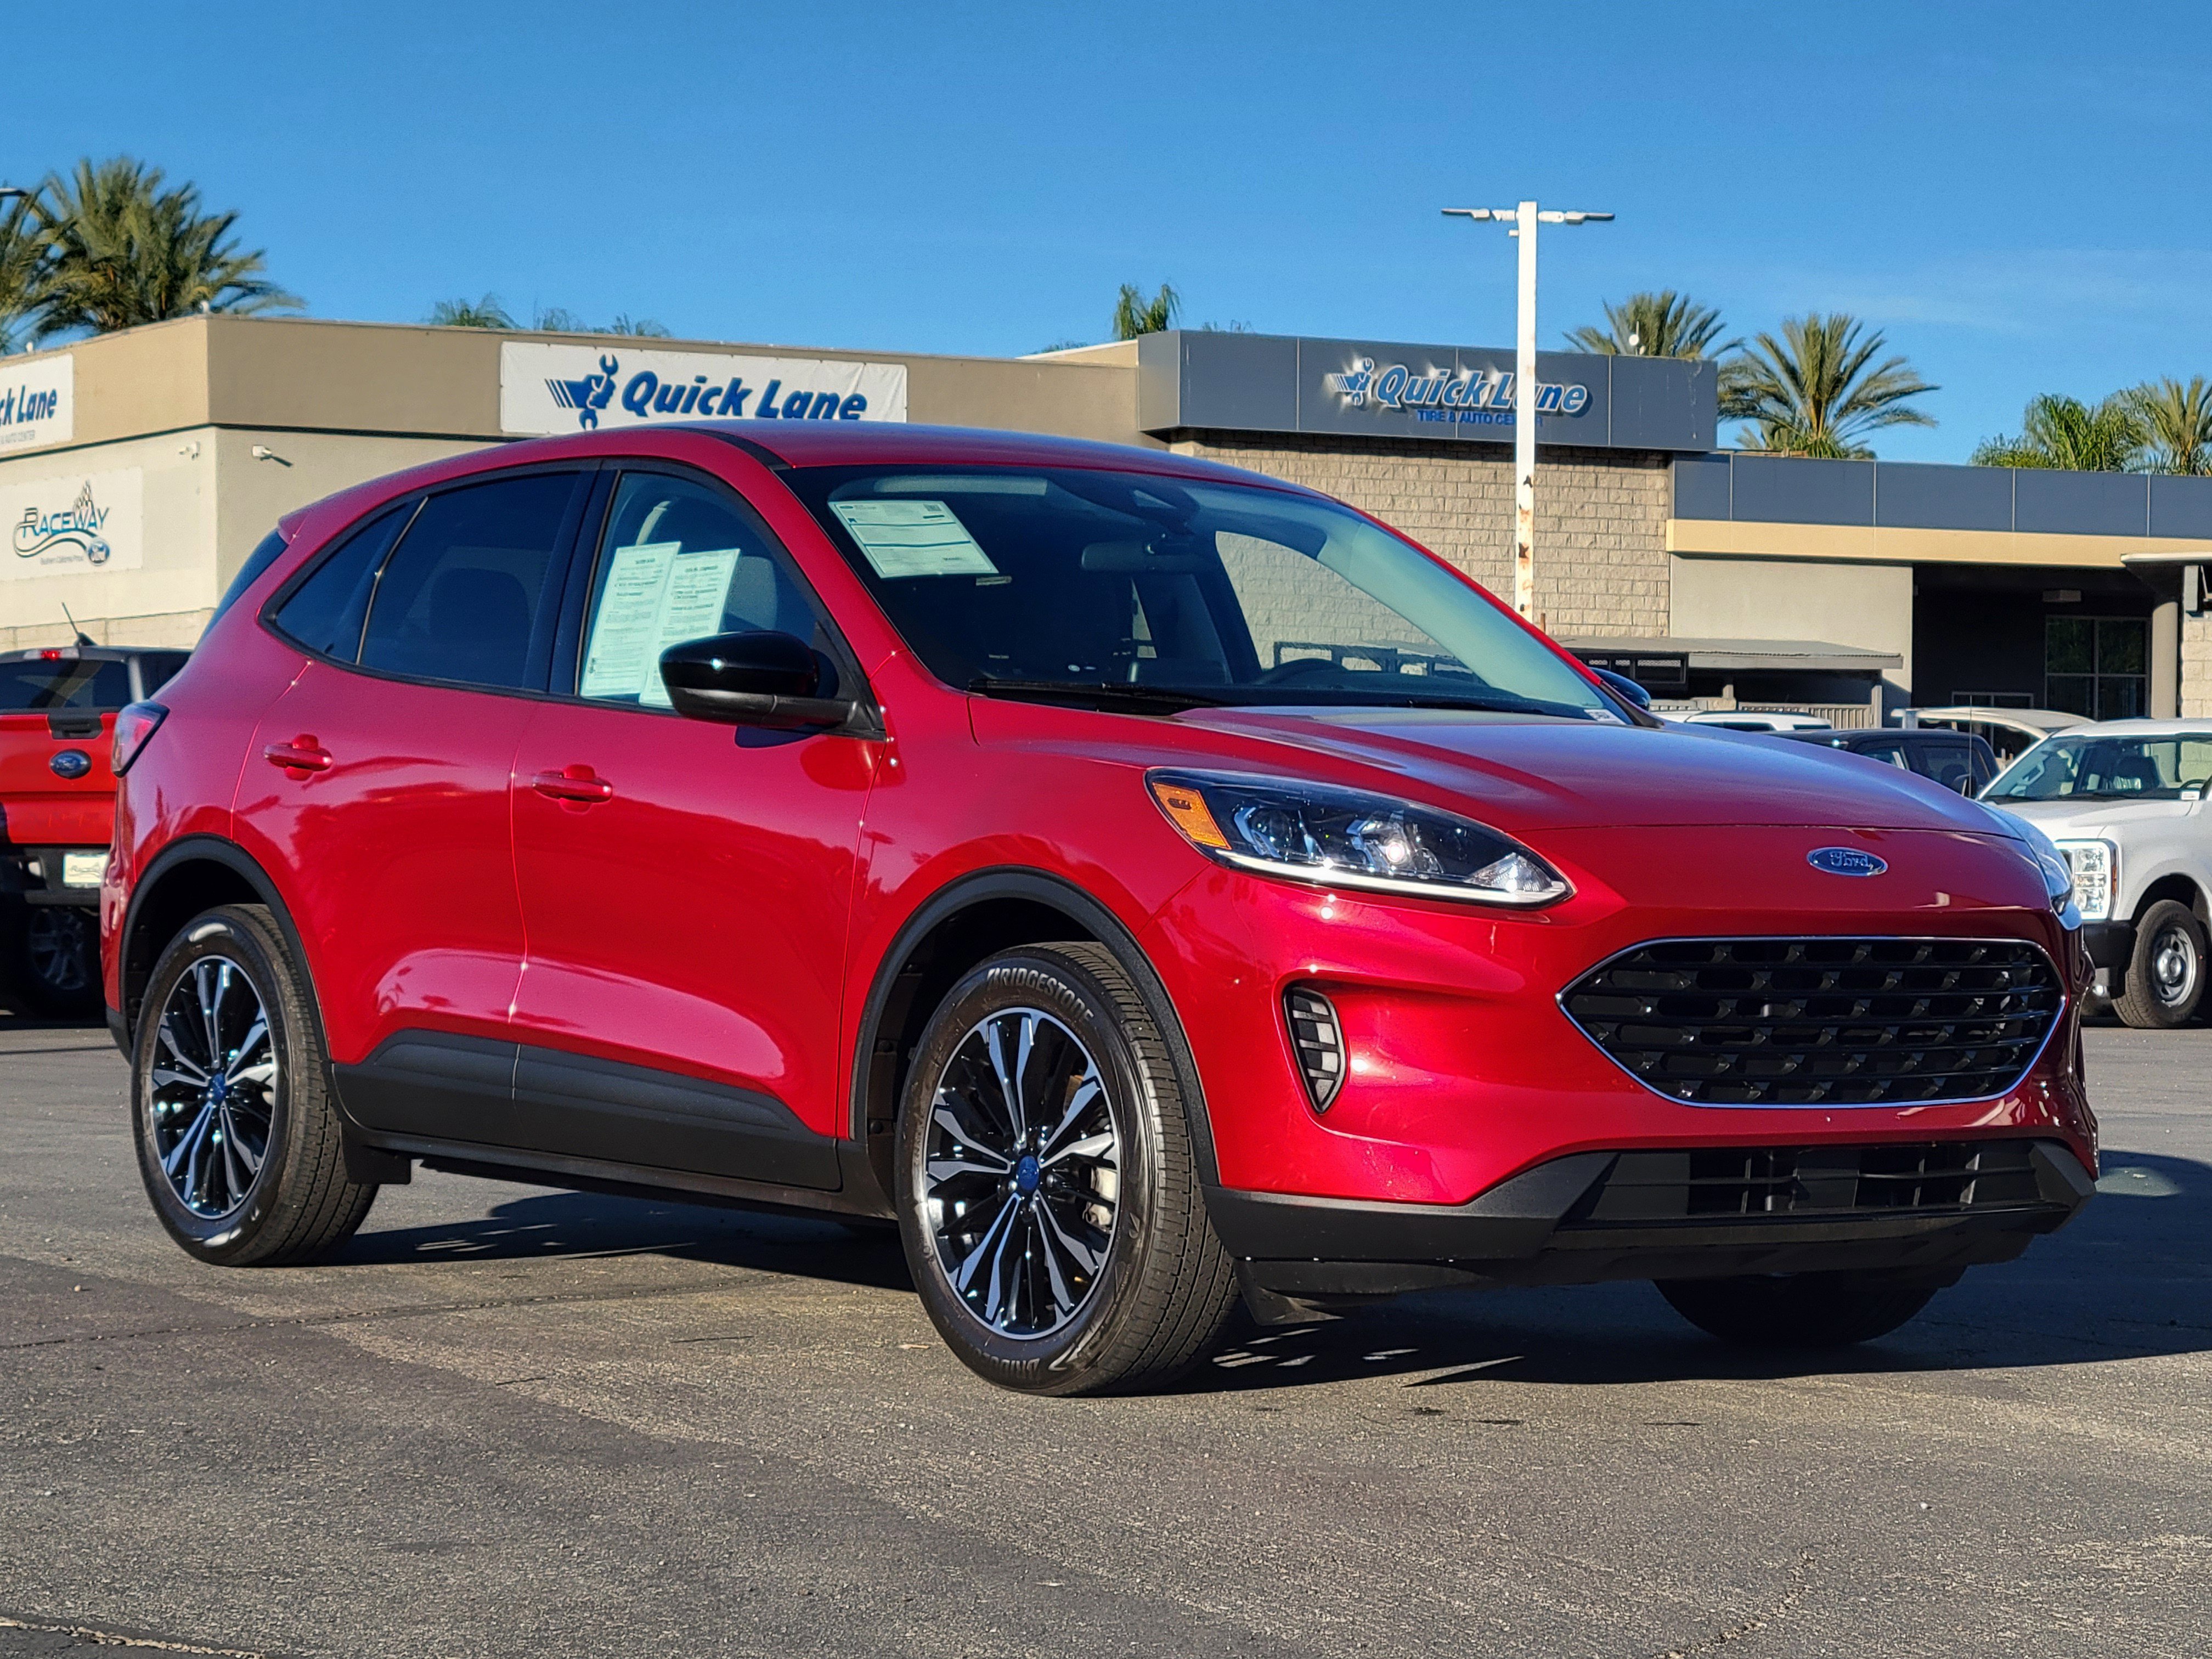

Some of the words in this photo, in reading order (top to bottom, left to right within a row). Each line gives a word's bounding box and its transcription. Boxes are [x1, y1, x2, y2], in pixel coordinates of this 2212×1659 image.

[16, 385, 57, 423] Lane
[621, 370, 753, 417] Quick
[755, 379, 867, 420] Lane
[1376, 365, 1488, 408] Quick
[1417, 409, 1445, 422] TIRE
[1459, 412, 1492, 425] AUTO
[1494, 414, 1543, 427] CER
[22, 501, 109, 538] RACEWAY
[1829, 851, 1874, 870] Ford
[987, 967, 1094, 1022] BRIDGESTONE
